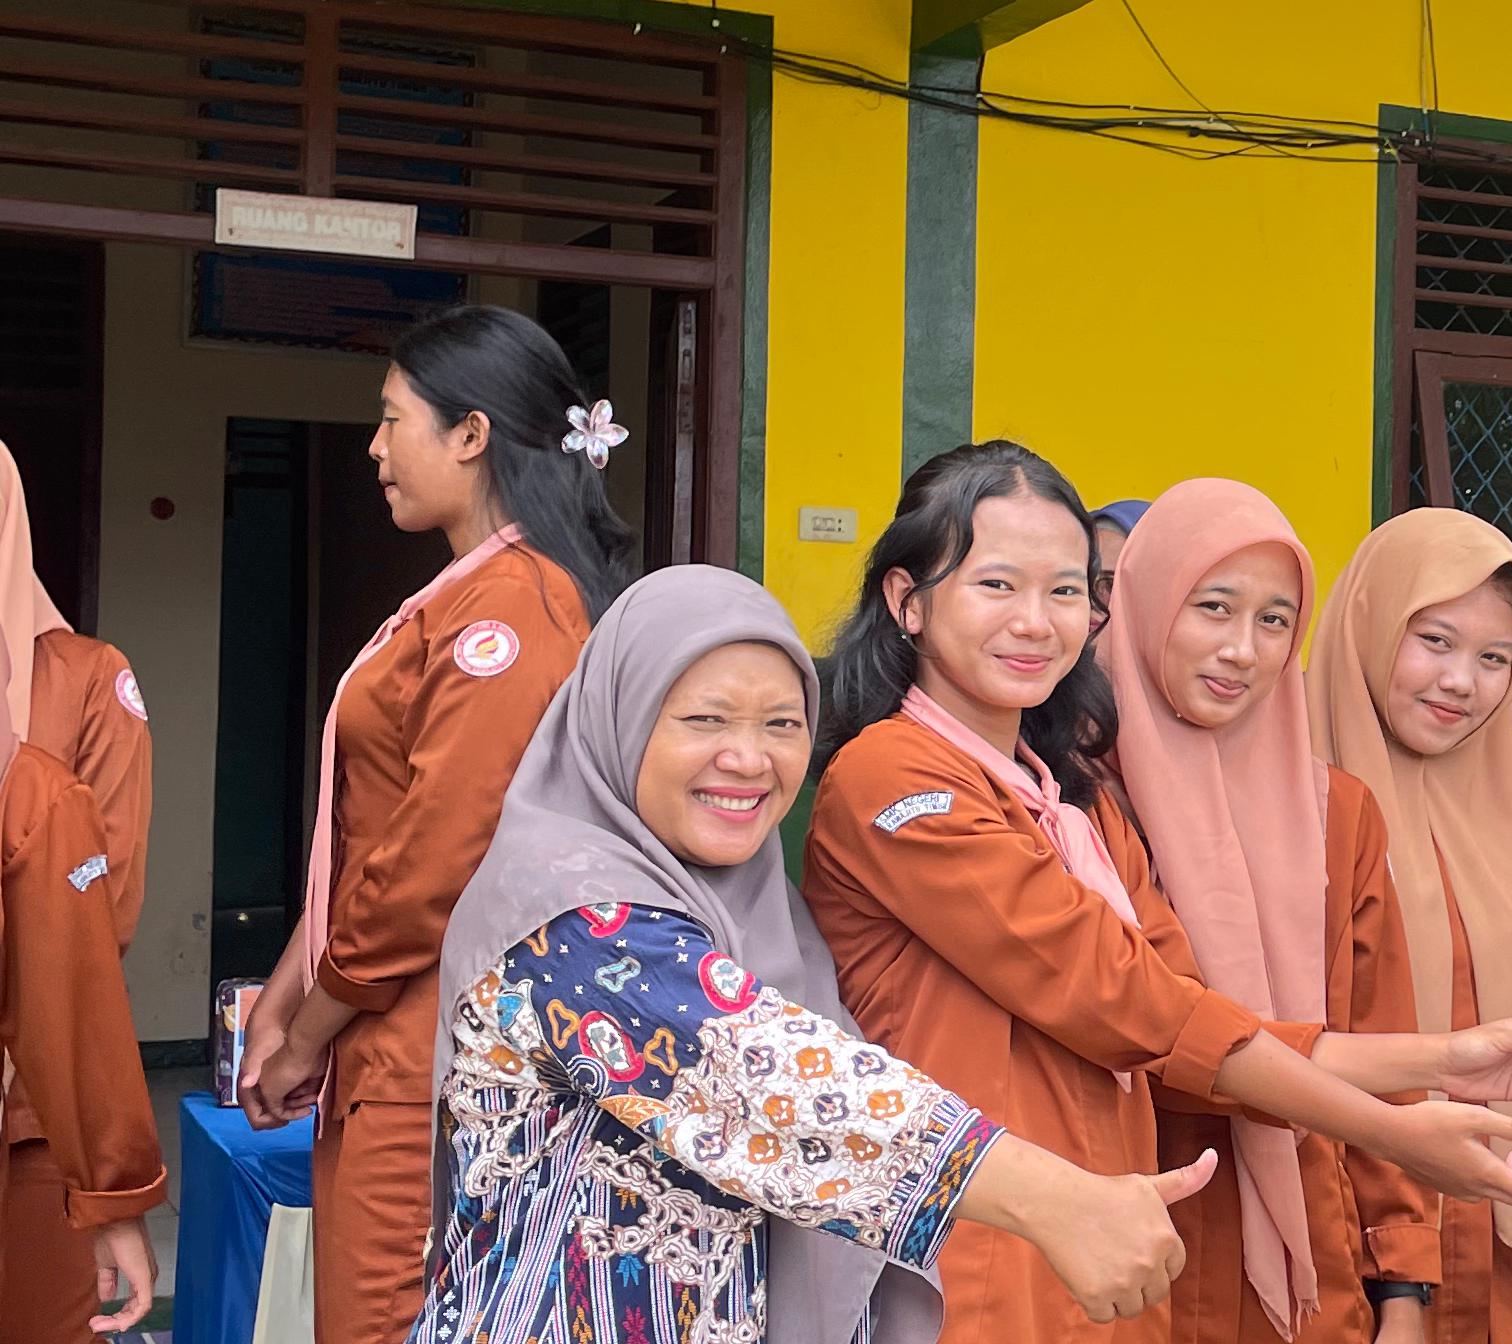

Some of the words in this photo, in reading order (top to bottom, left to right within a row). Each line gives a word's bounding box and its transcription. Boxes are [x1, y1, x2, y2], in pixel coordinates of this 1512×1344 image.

[232, 206, 307, 232] RUANG
[880, 806, 897, 824] SMK
[903, 794, 940, 808] NEGERI
